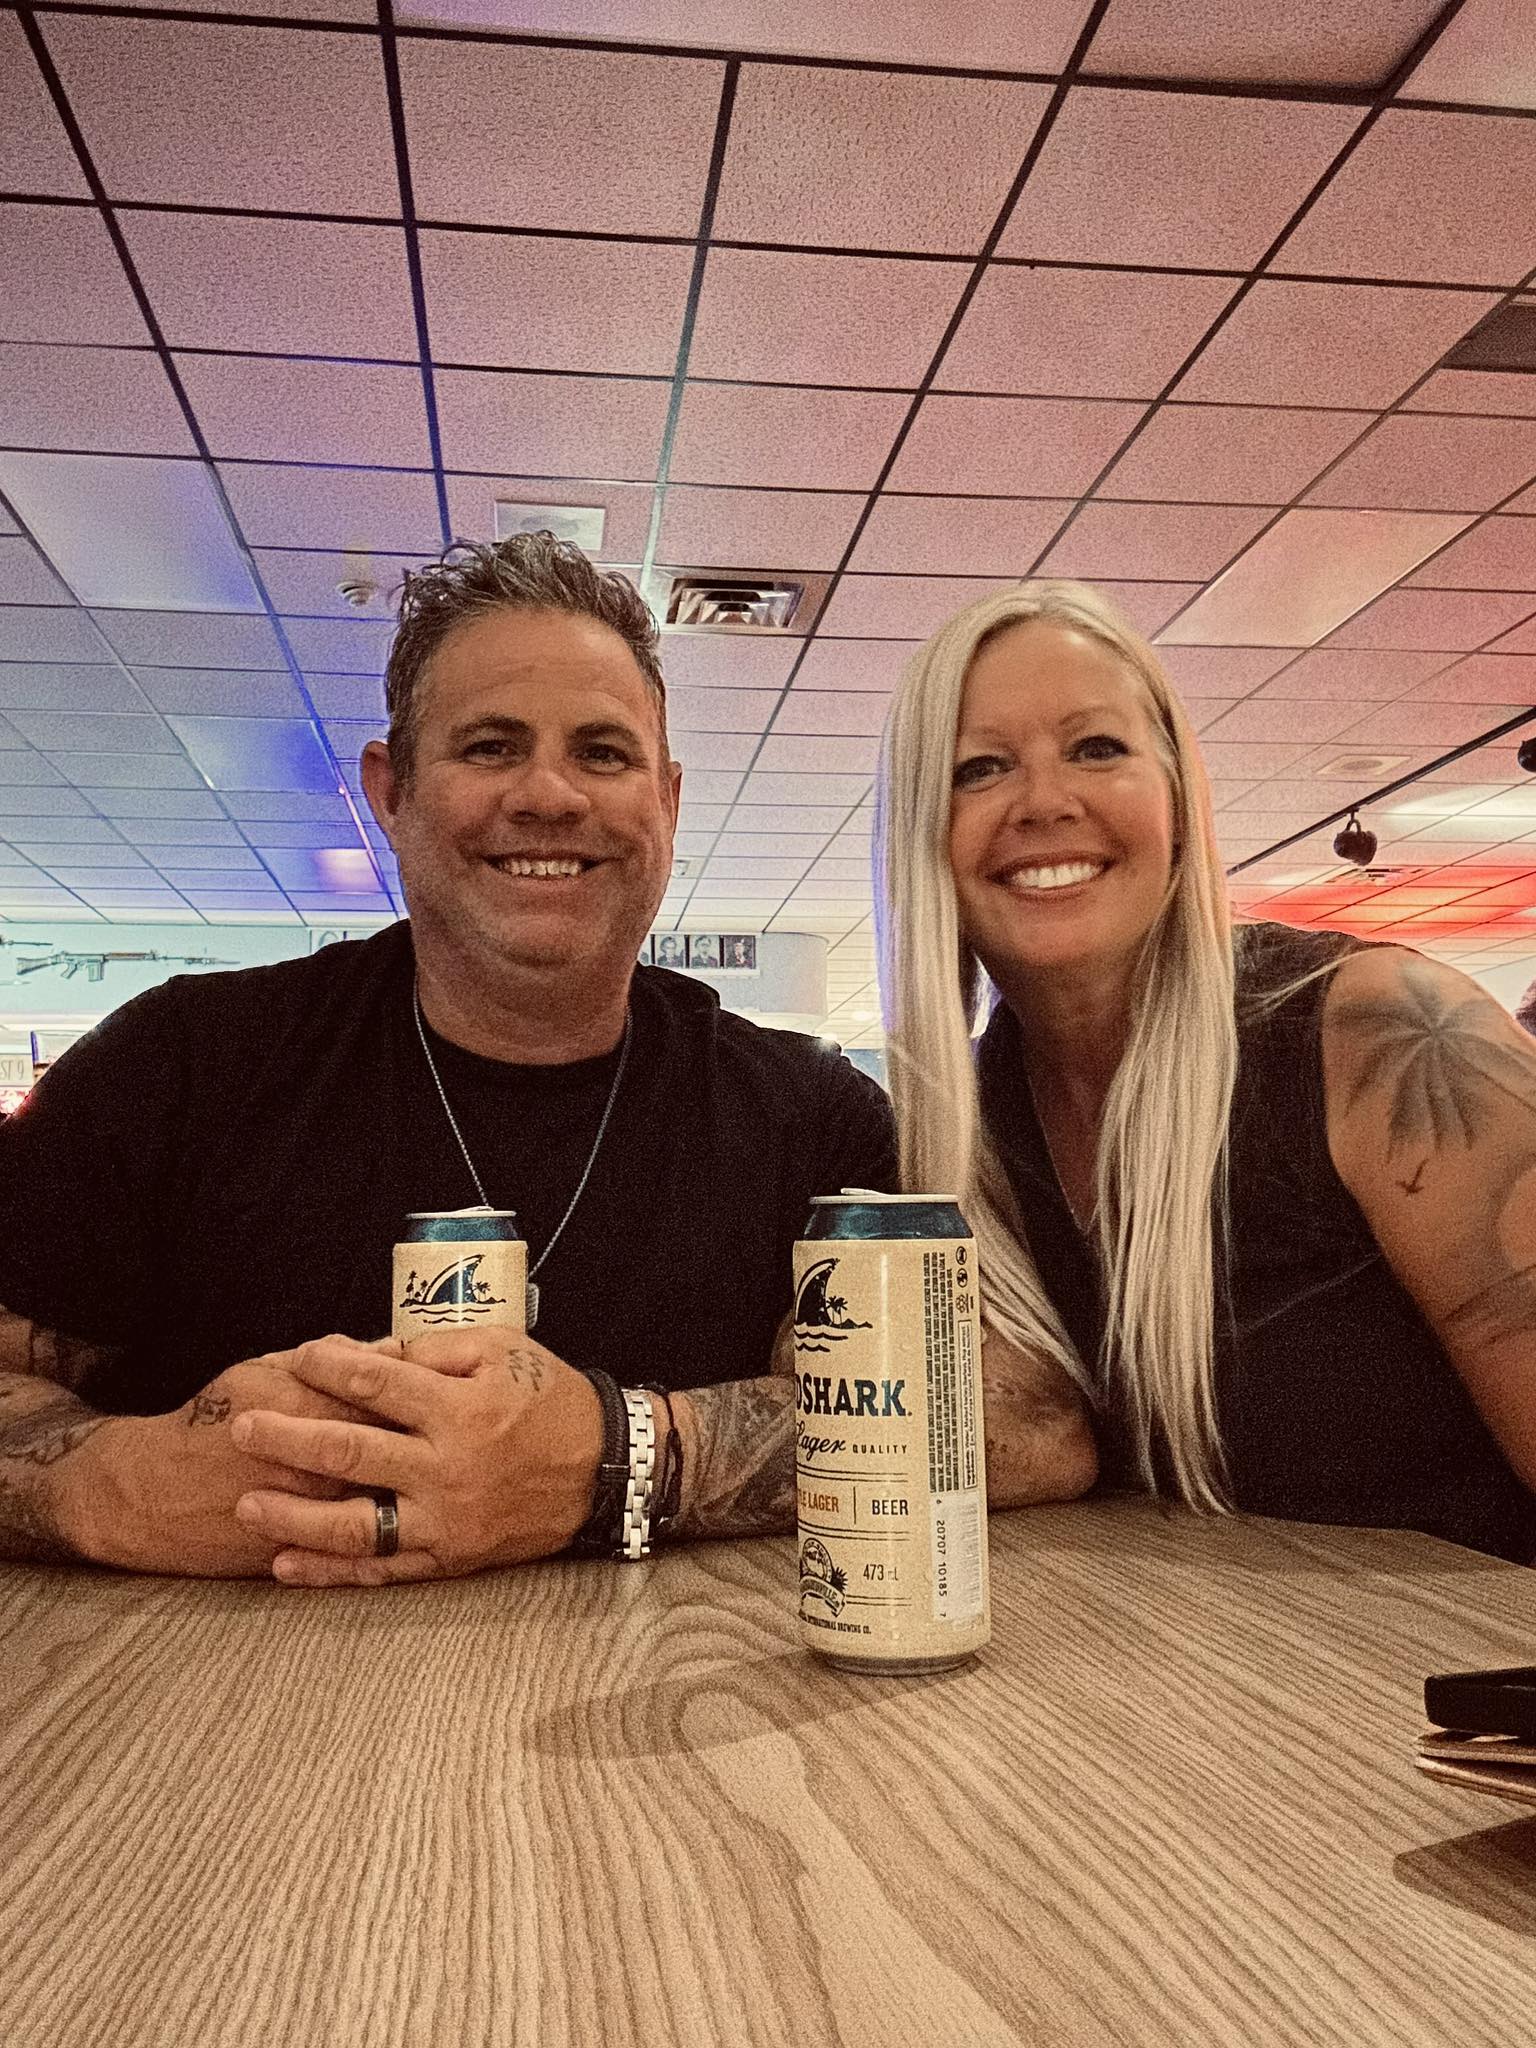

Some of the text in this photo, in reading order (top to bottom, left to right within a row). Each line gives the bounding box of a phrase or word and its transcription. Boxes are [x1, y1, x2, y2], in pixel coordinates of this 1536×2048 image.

[852, 1443, 908, 1454] QUALITY
[808, 1492, 840, 1513] LAGER
[871, 1499, 909, 1516] BEER
[936, 1520, 946, 1555] 20707
[863, 1563, 884, 1581] 473
[938, 1562, 948, 1597] 10185
